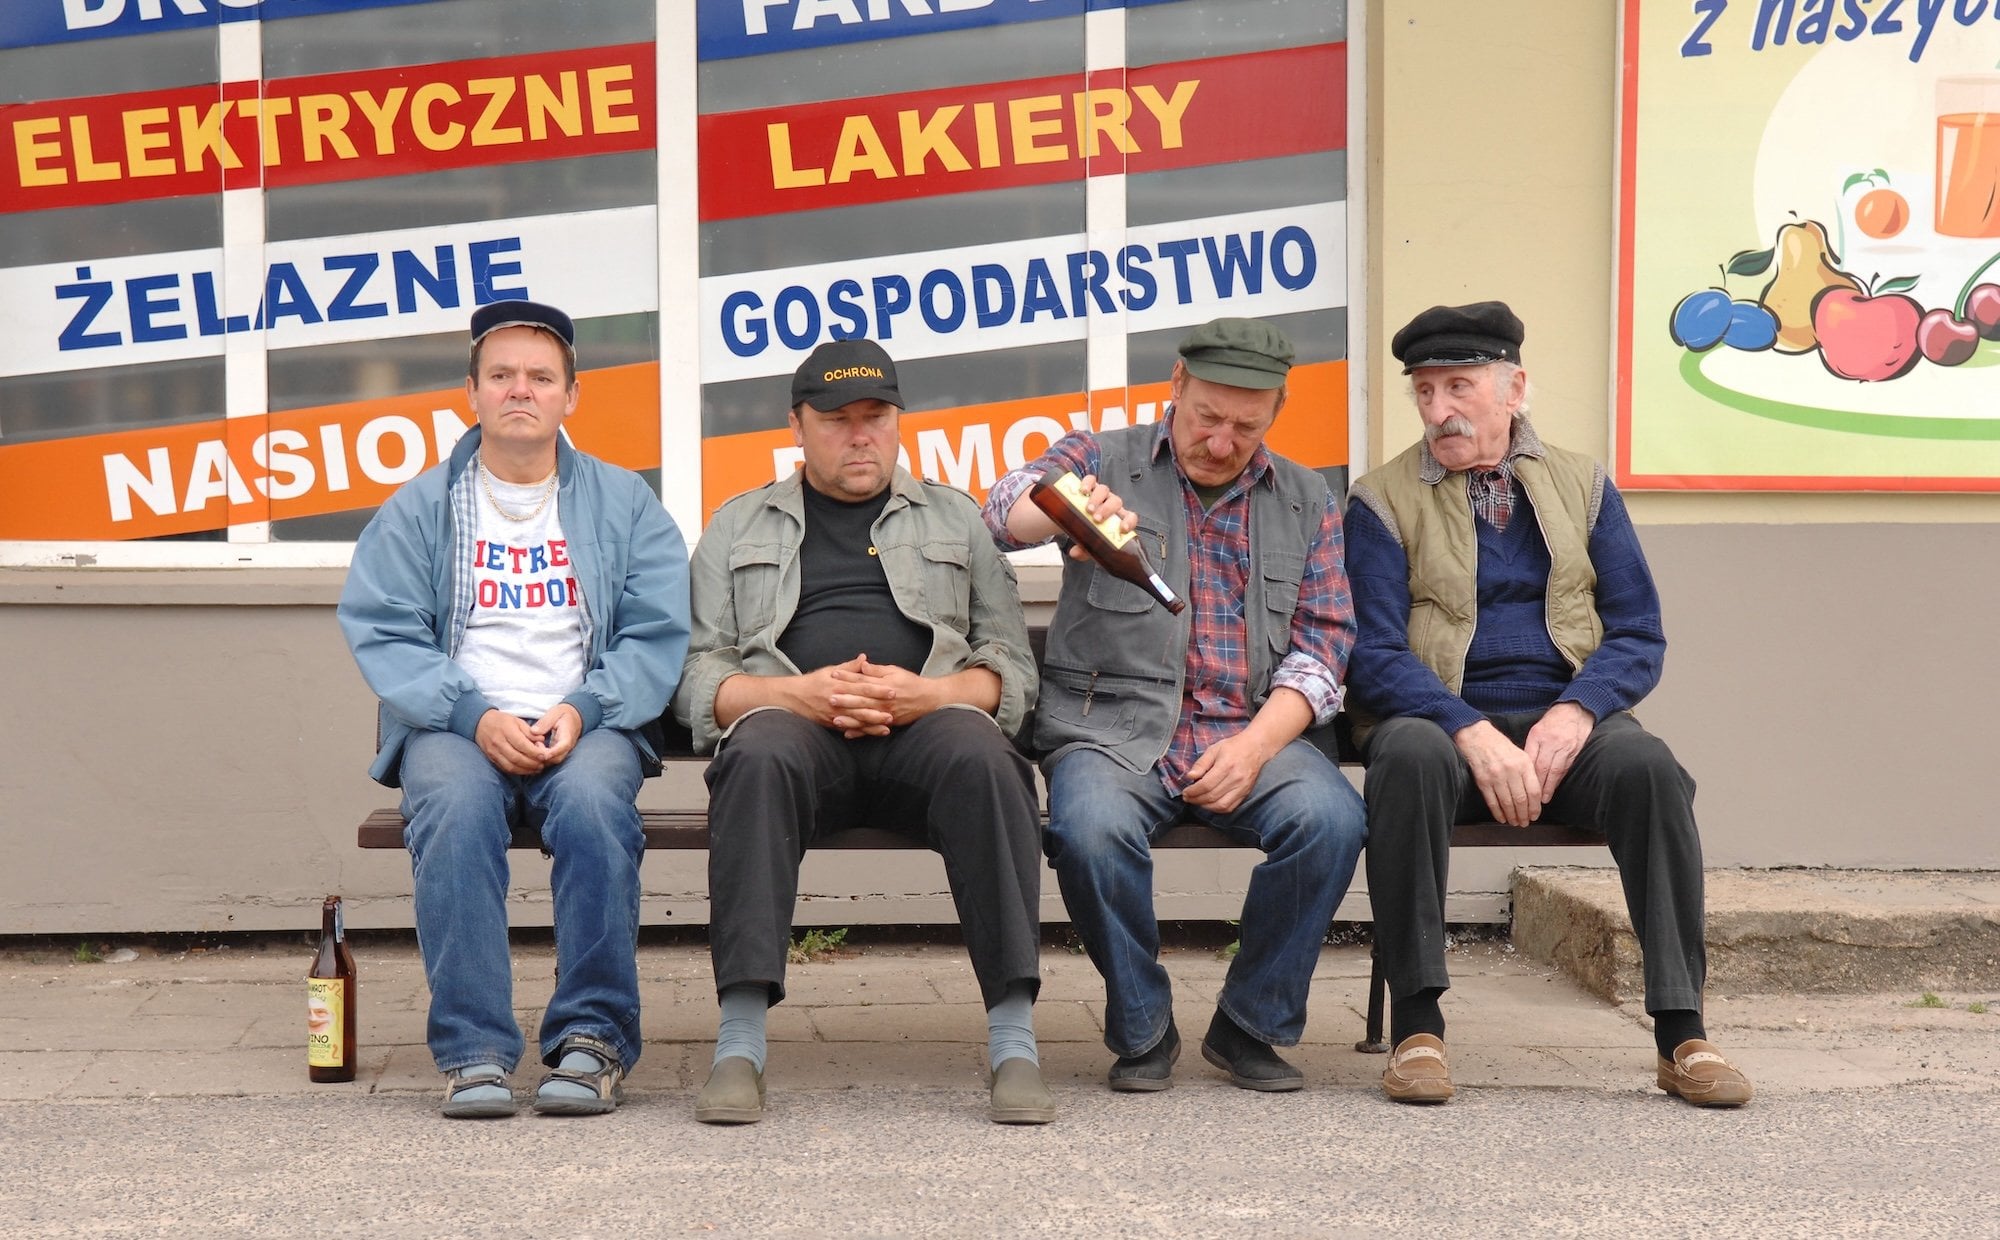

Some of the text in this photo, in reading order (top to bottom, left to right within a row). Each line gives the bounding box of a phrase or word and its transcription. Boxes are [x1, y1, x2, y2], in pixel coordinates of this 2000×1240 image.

[1752, 0, 2000, 63] naszy
[12, 64, 640, 188] ELEKTRYCZNE
[767, 80, 1200, 190] LAKIERY
[55, 237, 529, 352] ŻELAZNE
[720, 225, 1317, 358] GOSPODARSTWO
[824, 366, 884, 382] OCHRONA
[474, 539, 569, 574] IETRE
[310, 1034, 329, 1043] INO
